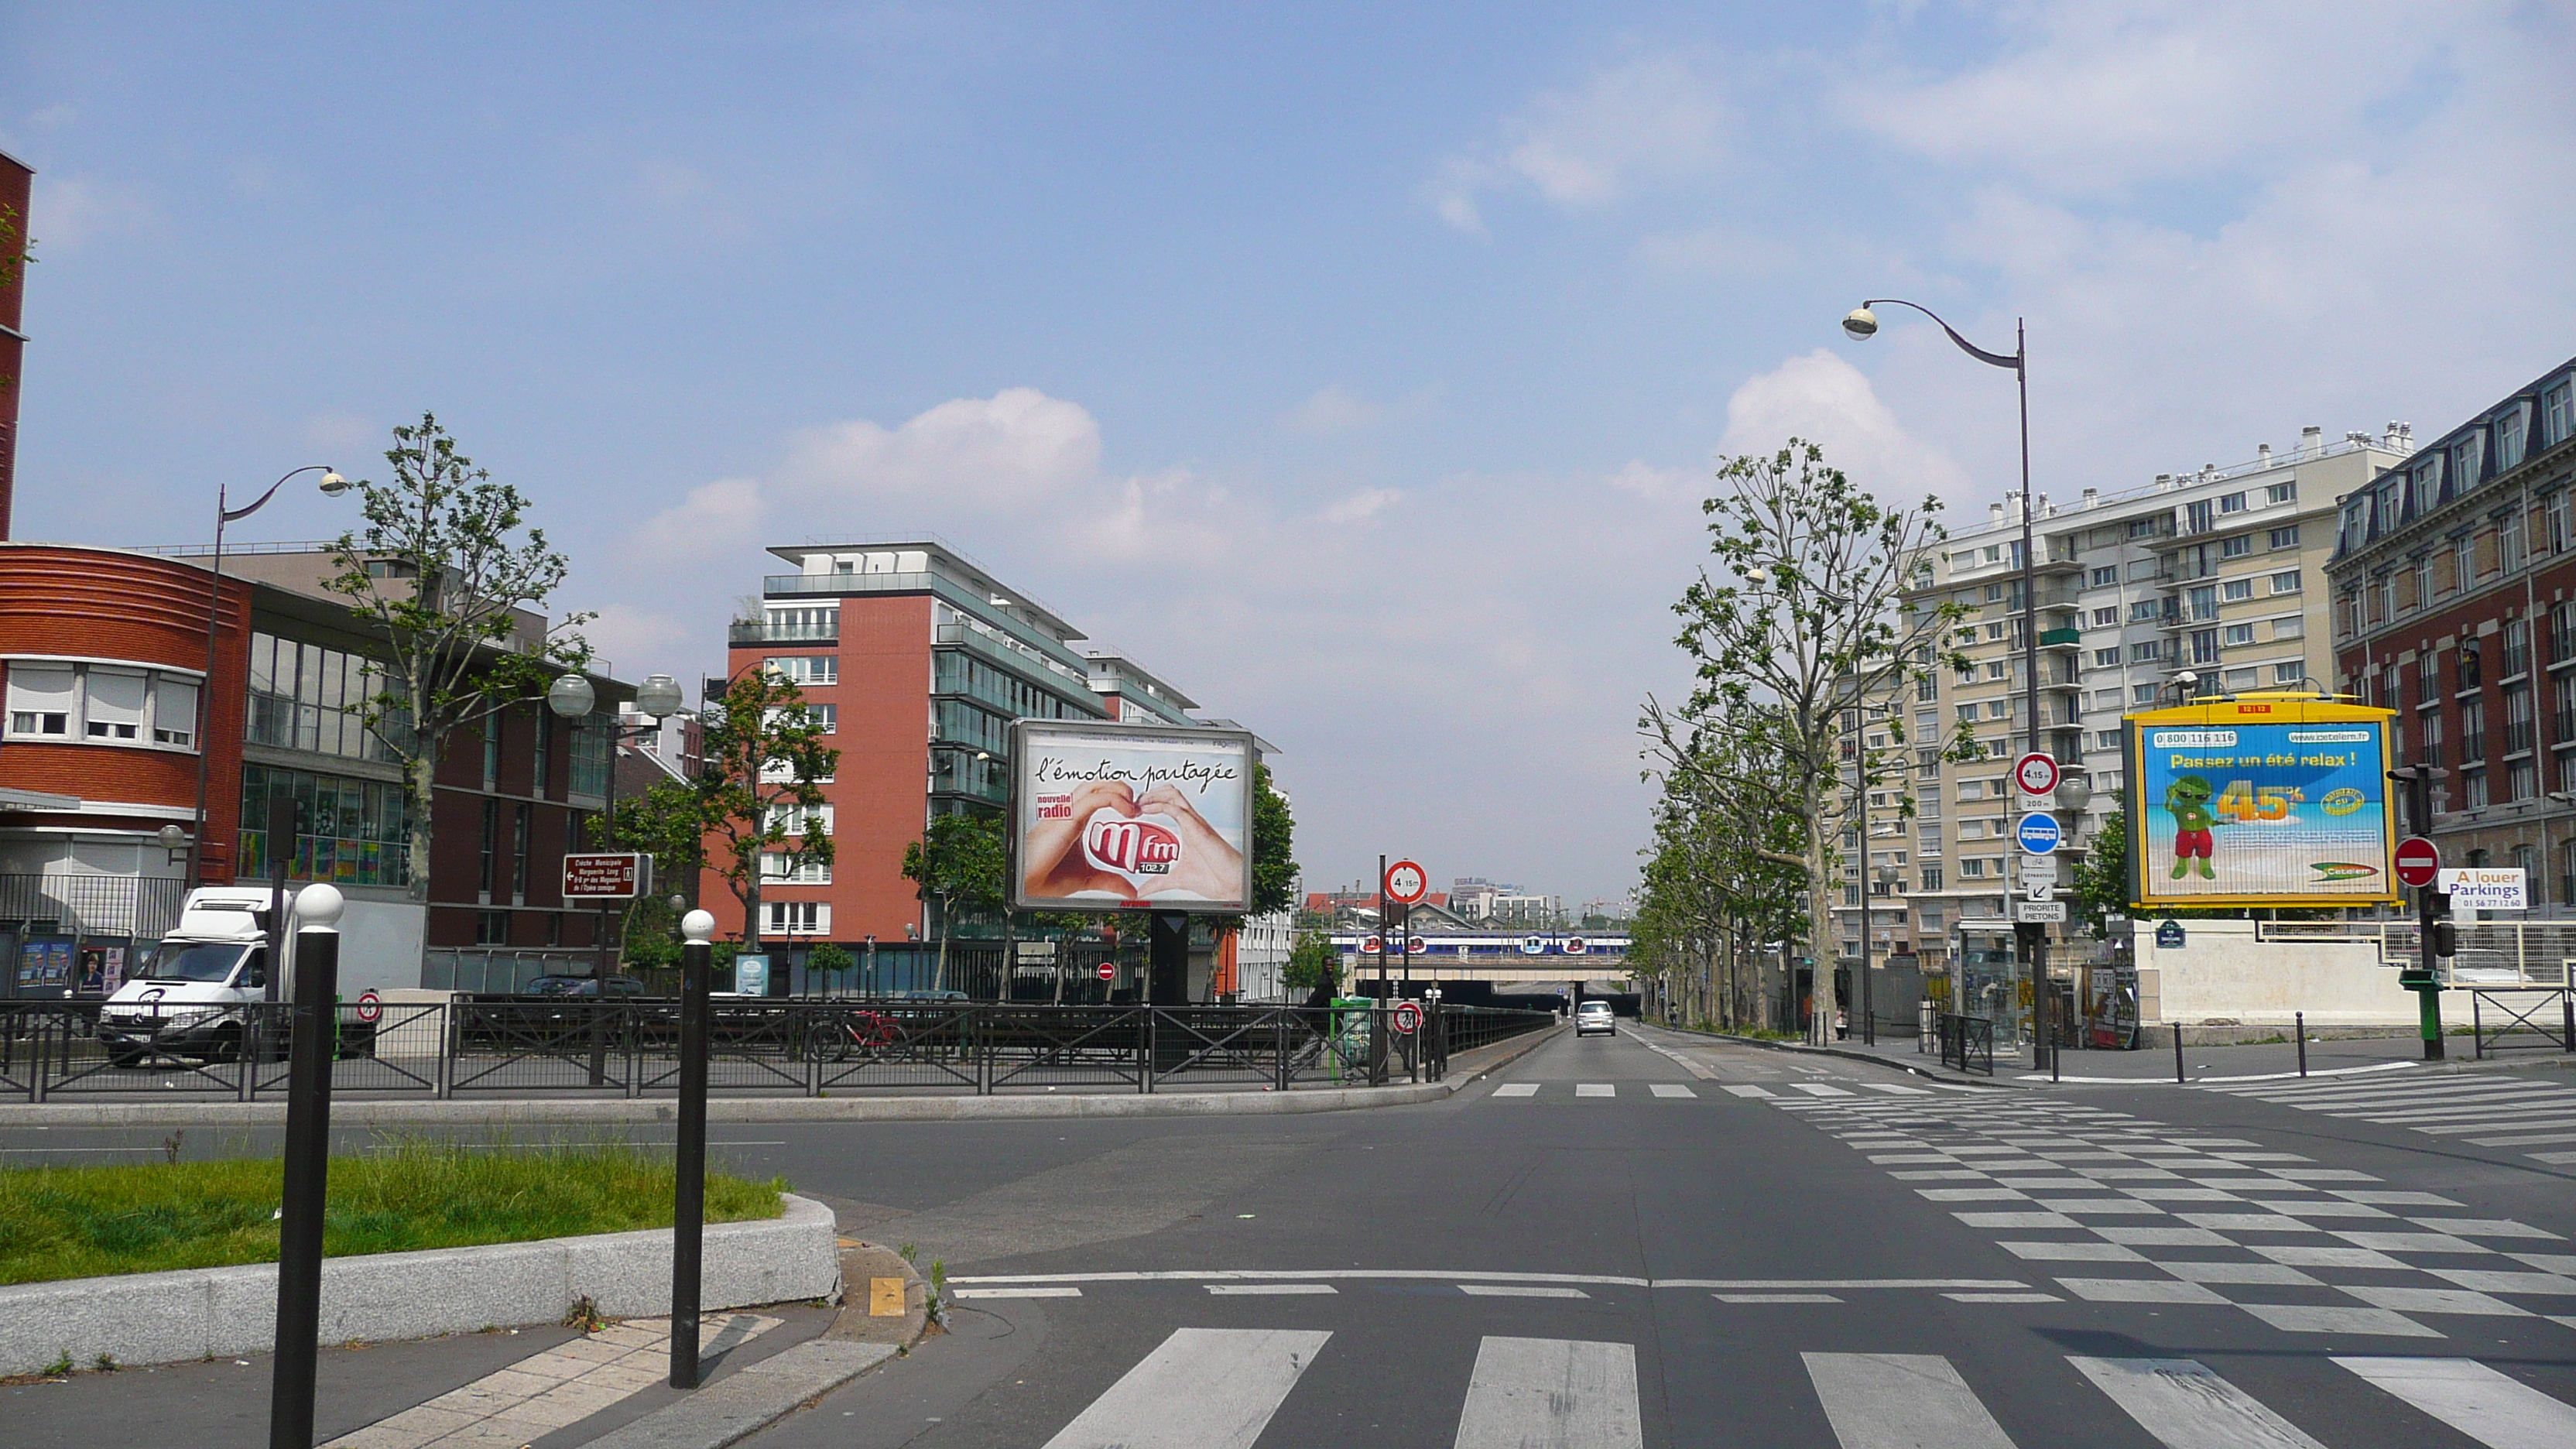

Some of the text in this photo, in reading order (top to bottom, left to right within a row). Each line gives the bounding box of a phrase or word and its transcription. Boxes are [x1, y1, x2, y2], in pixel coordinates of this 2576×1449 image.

[2156, 732, 2235, 743] 0 800 116 116
[2290, 732, 2368, 742] www.cetelem.fr
[2170, 752, 2356, 769] Passez un été relax !
[1036, 756, 1238, 794] l'émotion partagée
[2024, 769, 2043, 779] 4.15
[1037, 794, 1071, 804] nouvelle
[1038, 805, 1072, 818] radio
[2457, 871, 2519, 882] A louer
[2450, 883, 2519, 899] Parkings
